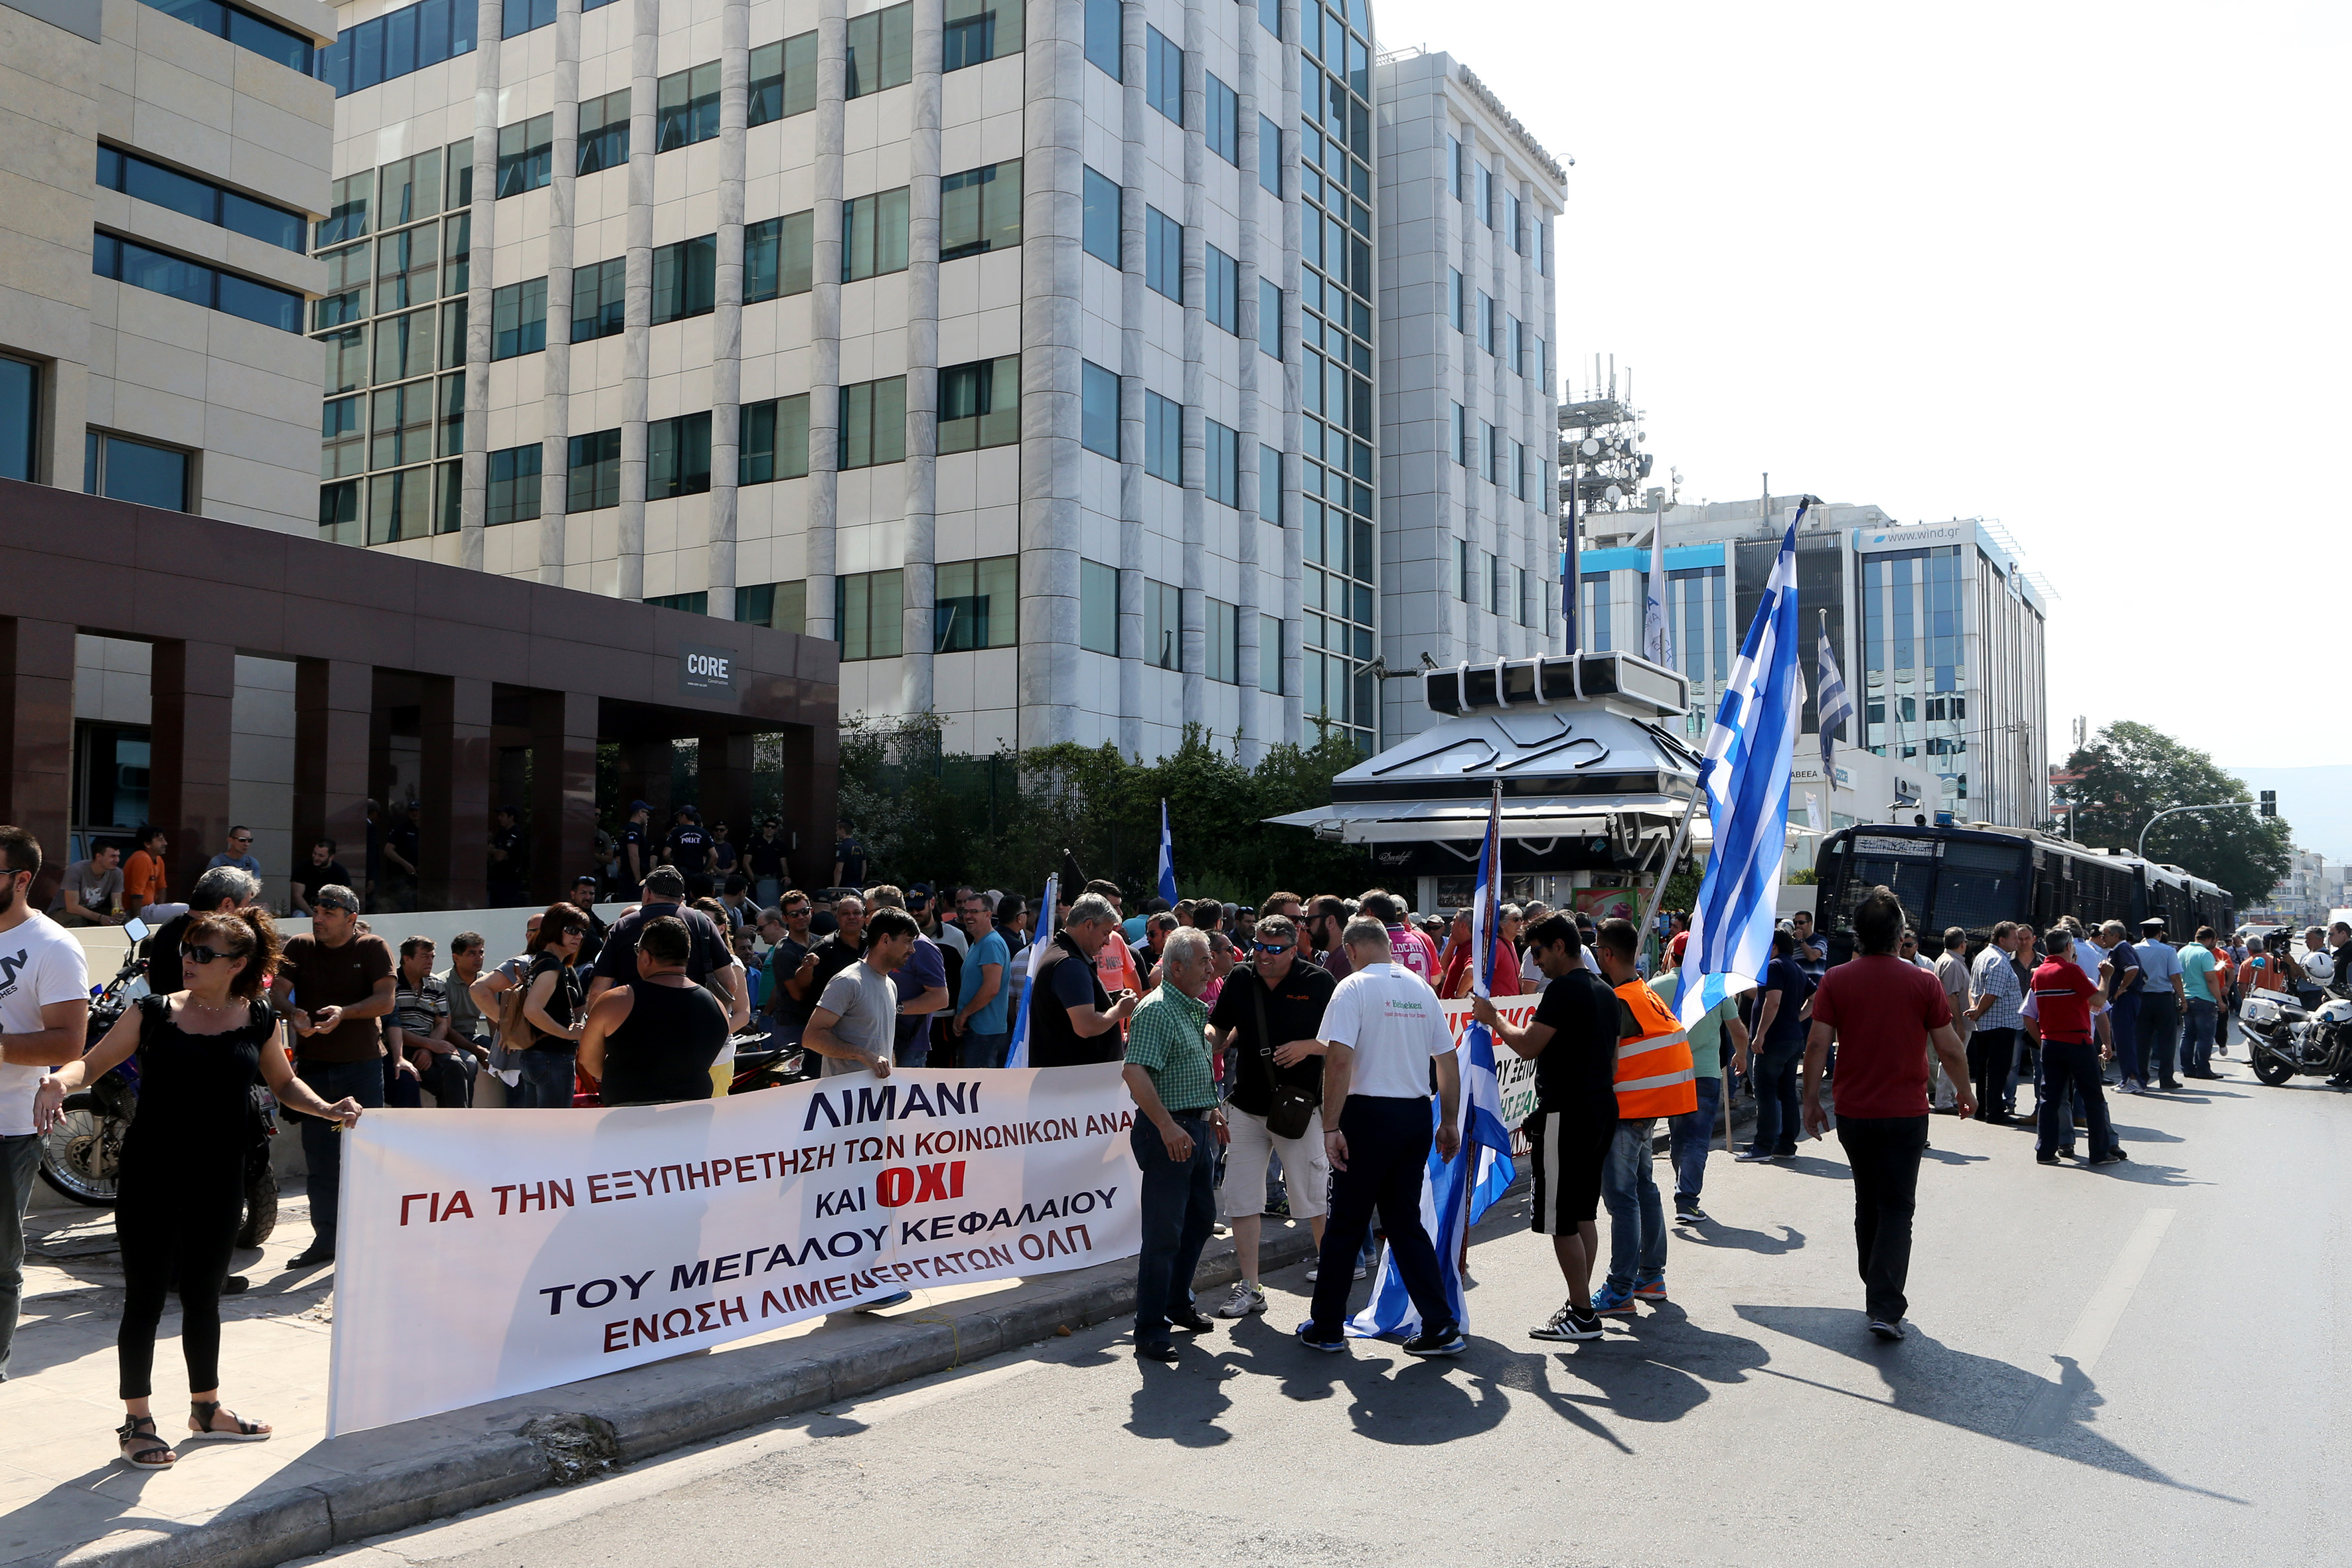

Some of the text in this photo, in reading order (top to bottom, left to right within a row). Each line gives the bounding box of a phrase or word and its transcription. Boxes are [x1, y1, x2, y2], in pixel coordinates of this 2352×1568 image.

[1888, 528, 1960, 542] www.wind.gr
[688, 654, 728, 678] CORE
[803, 1081, 982, 1132] ΛΙΜΑΝΙ
[399, 1109, 1138, 1226] ΓΙΑ ΤΗΝ ΕΞΥΠΗΡΕΤΗΣΗ ΤΩΝ ΚΟΙΝΩΝΙΚΩΝ ΑΝΑ
[815, 1160, 967, 1219] ΚΑΙ ΟΧΙ
[539, 1186, 1119, 1316] ΤΟΥ ΜΕΓΑΛΟΥ ΚΕΦΑΛΑΙΟΥ
[603, 1224, 1093, 1354] ΕΝΩΣΗ ΛΙΜΕΝΕΡΓΑΤΩΝ ΟΛΠ
